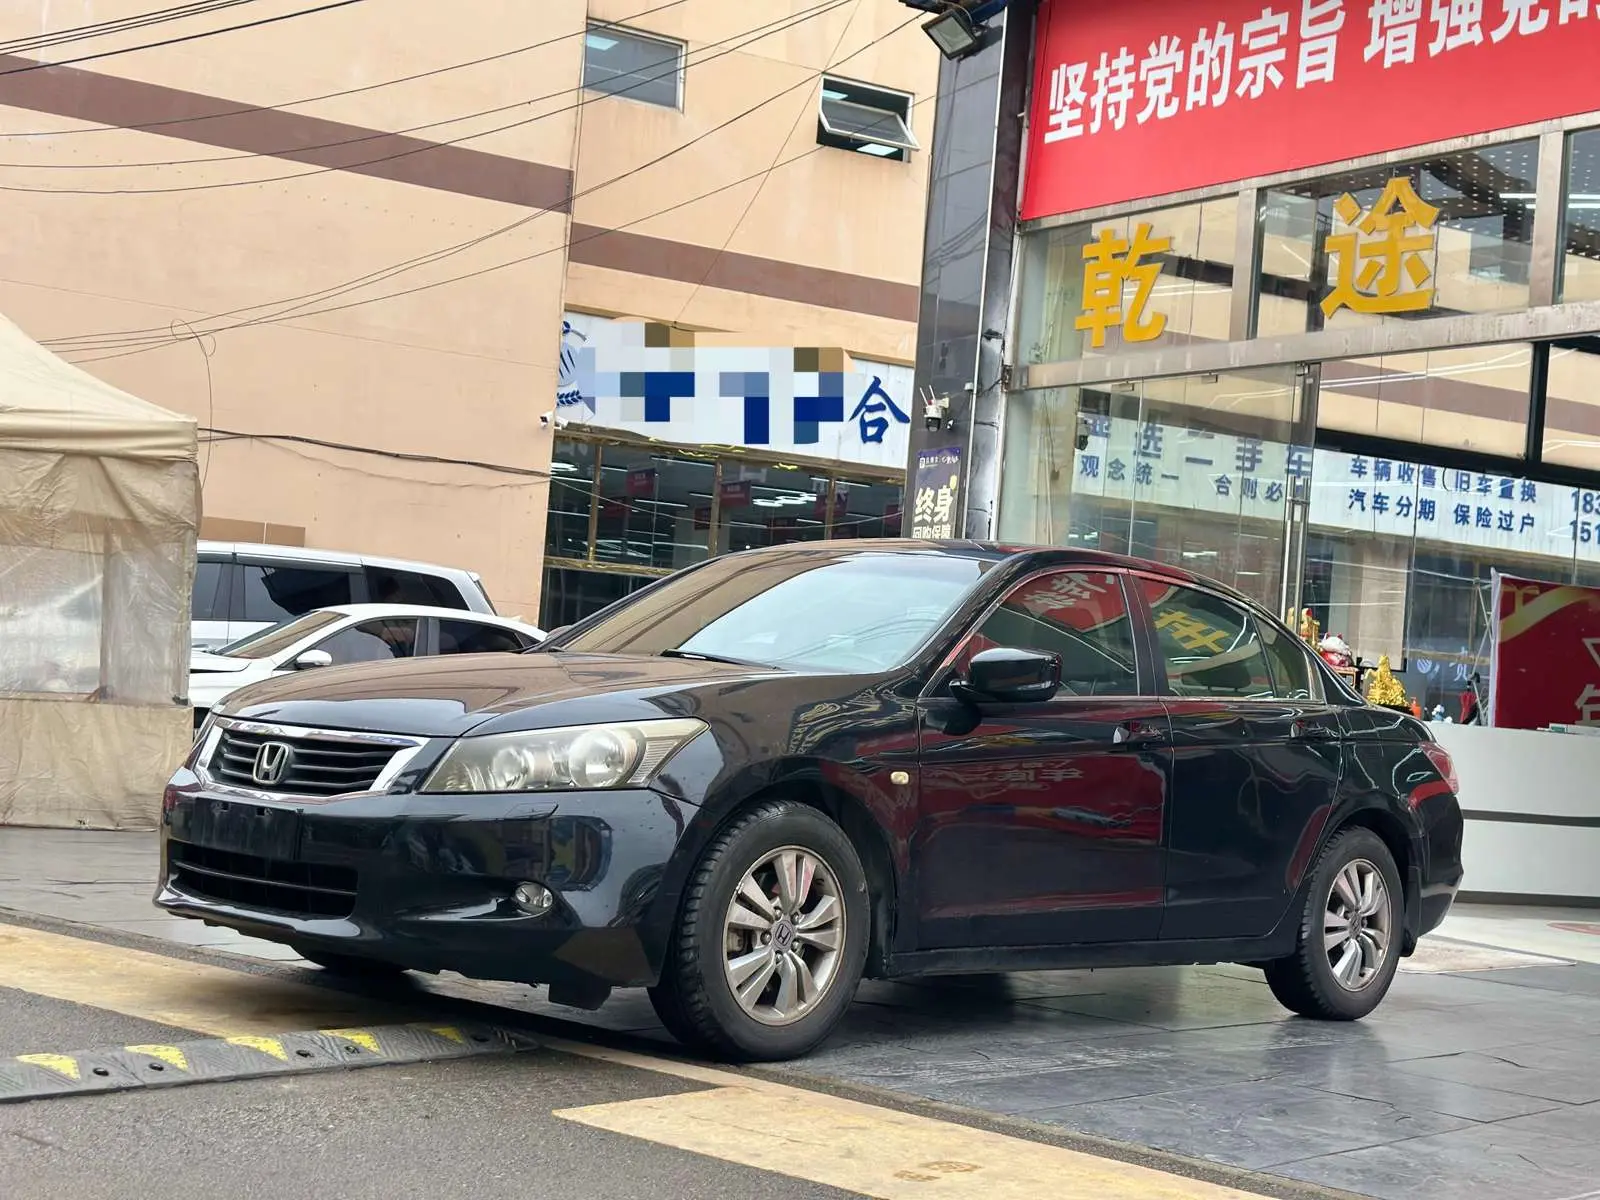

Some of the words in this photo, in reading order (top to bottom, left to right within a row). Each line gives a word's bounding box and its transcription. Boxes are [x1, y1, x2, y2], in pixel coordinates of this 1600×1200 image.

[1044, 0, 1346, 144] 坚持党的宗旨
[914, 485, 953, 523] 终身
[1349, 488, 1436, 521] 汽车分期
[1453, 503, 1535, 533] 保险过户
